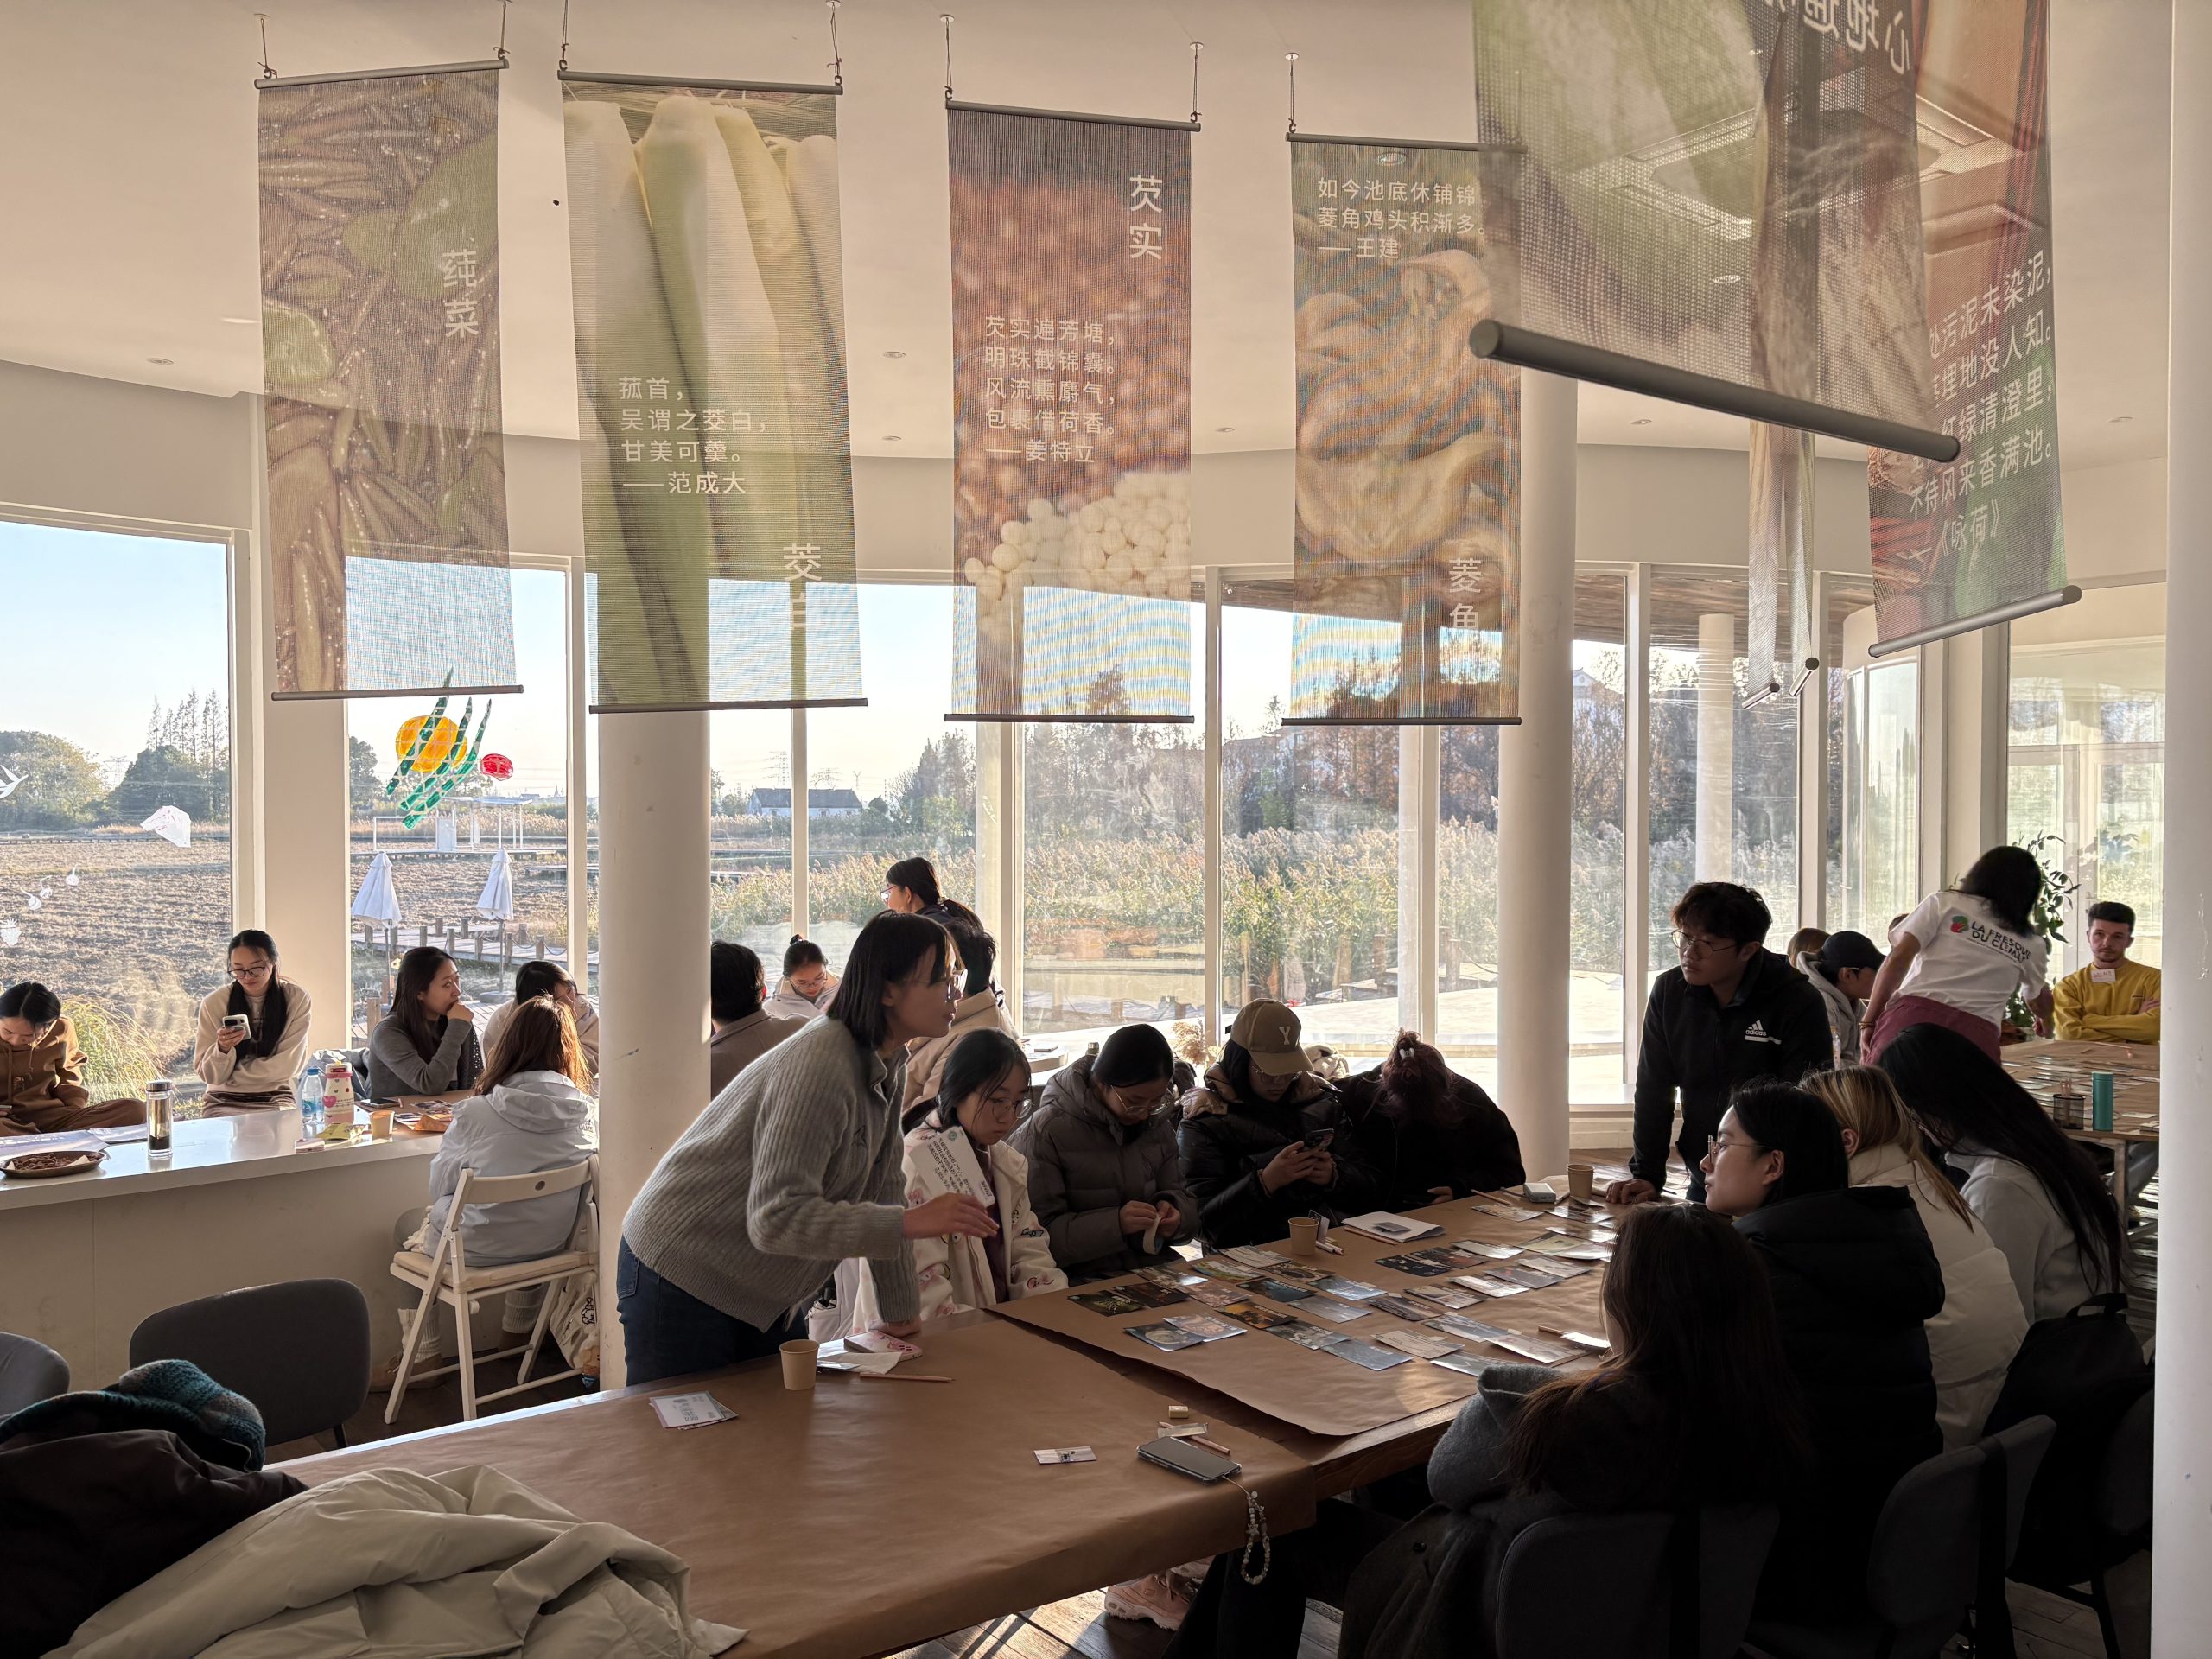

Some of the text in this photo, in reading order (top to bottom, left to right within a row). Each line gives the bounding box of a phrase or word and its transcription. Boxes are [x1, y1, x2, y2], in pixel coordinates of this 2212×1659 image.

[1128, 174, 1163, 260] 芡实
[442, 248, 479, 339] 莼菜
[1971, 921, 1986, 933] LA
[1972, 931, 1989, 942] DU
[1279, 1027, 1291, 1045] Y
